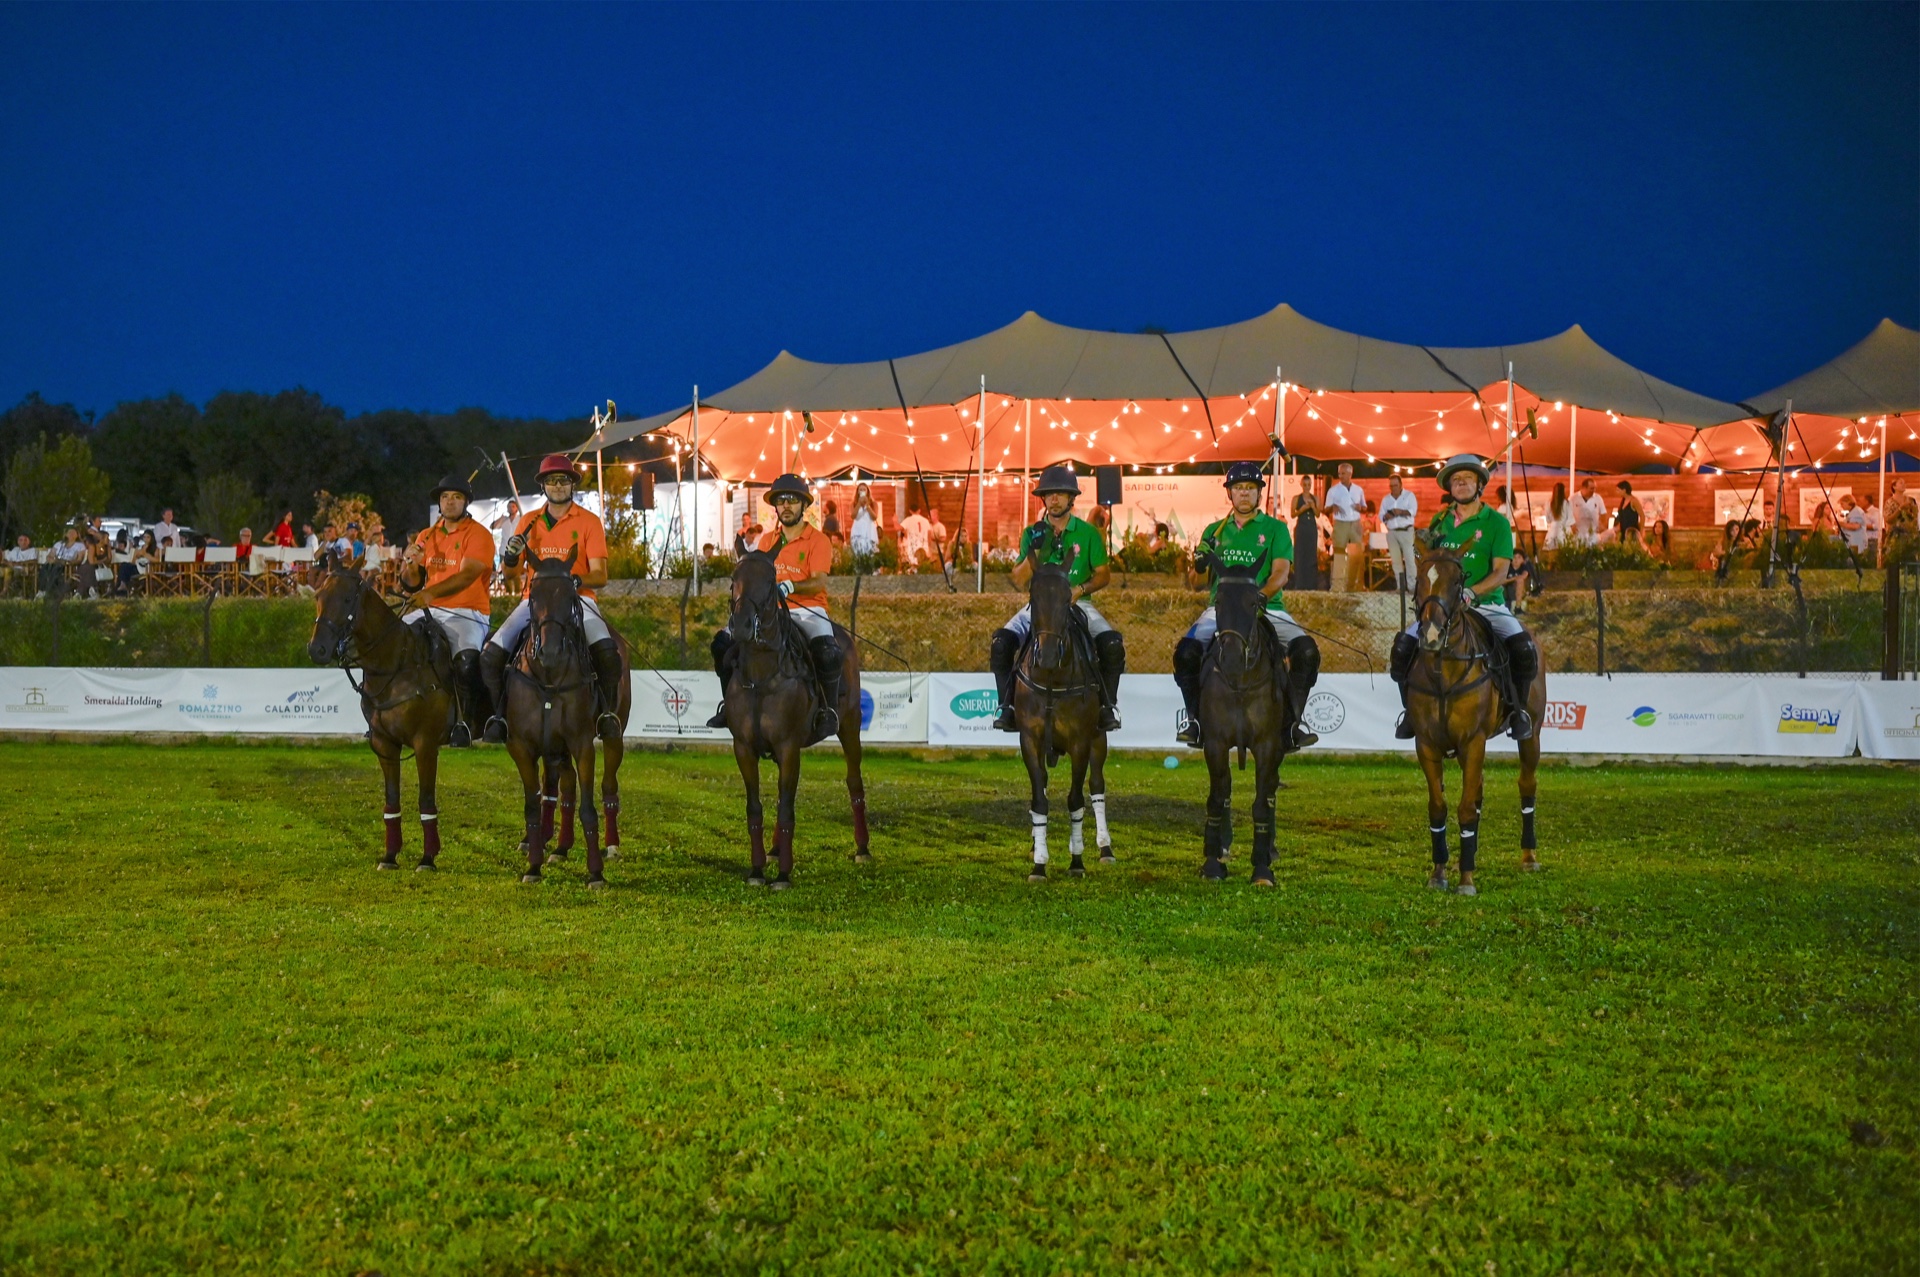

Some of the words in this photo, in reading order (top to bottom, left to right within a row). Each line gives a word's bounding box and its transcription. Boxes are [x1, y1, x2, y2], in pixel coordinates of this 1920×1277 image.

[1124, 483, 1179, 492] SARDEGNA
[1223, 549, 1253, 557] COSTA
[84, 695, 163, 708] SmeraldaHolding
[879, 702, 905, 710] Italiana
[959, 698, 1002, 712] SMERALD
[1308, 694, 1340, 708] BOTTEGA
[178, 704, 242, 713] ROMAZZINO
[264, 705, 291, 714] CALA
[294, 705, 305, 714] DI
[308, 705, 339, 714] VOLPE
[1543, 703, 1577, 724] RDS
[879, 711, 898, 720] Sport
[879, 721, 908, 732] Equestri
[1305, 712, 1343, 732] CONTICELLI
